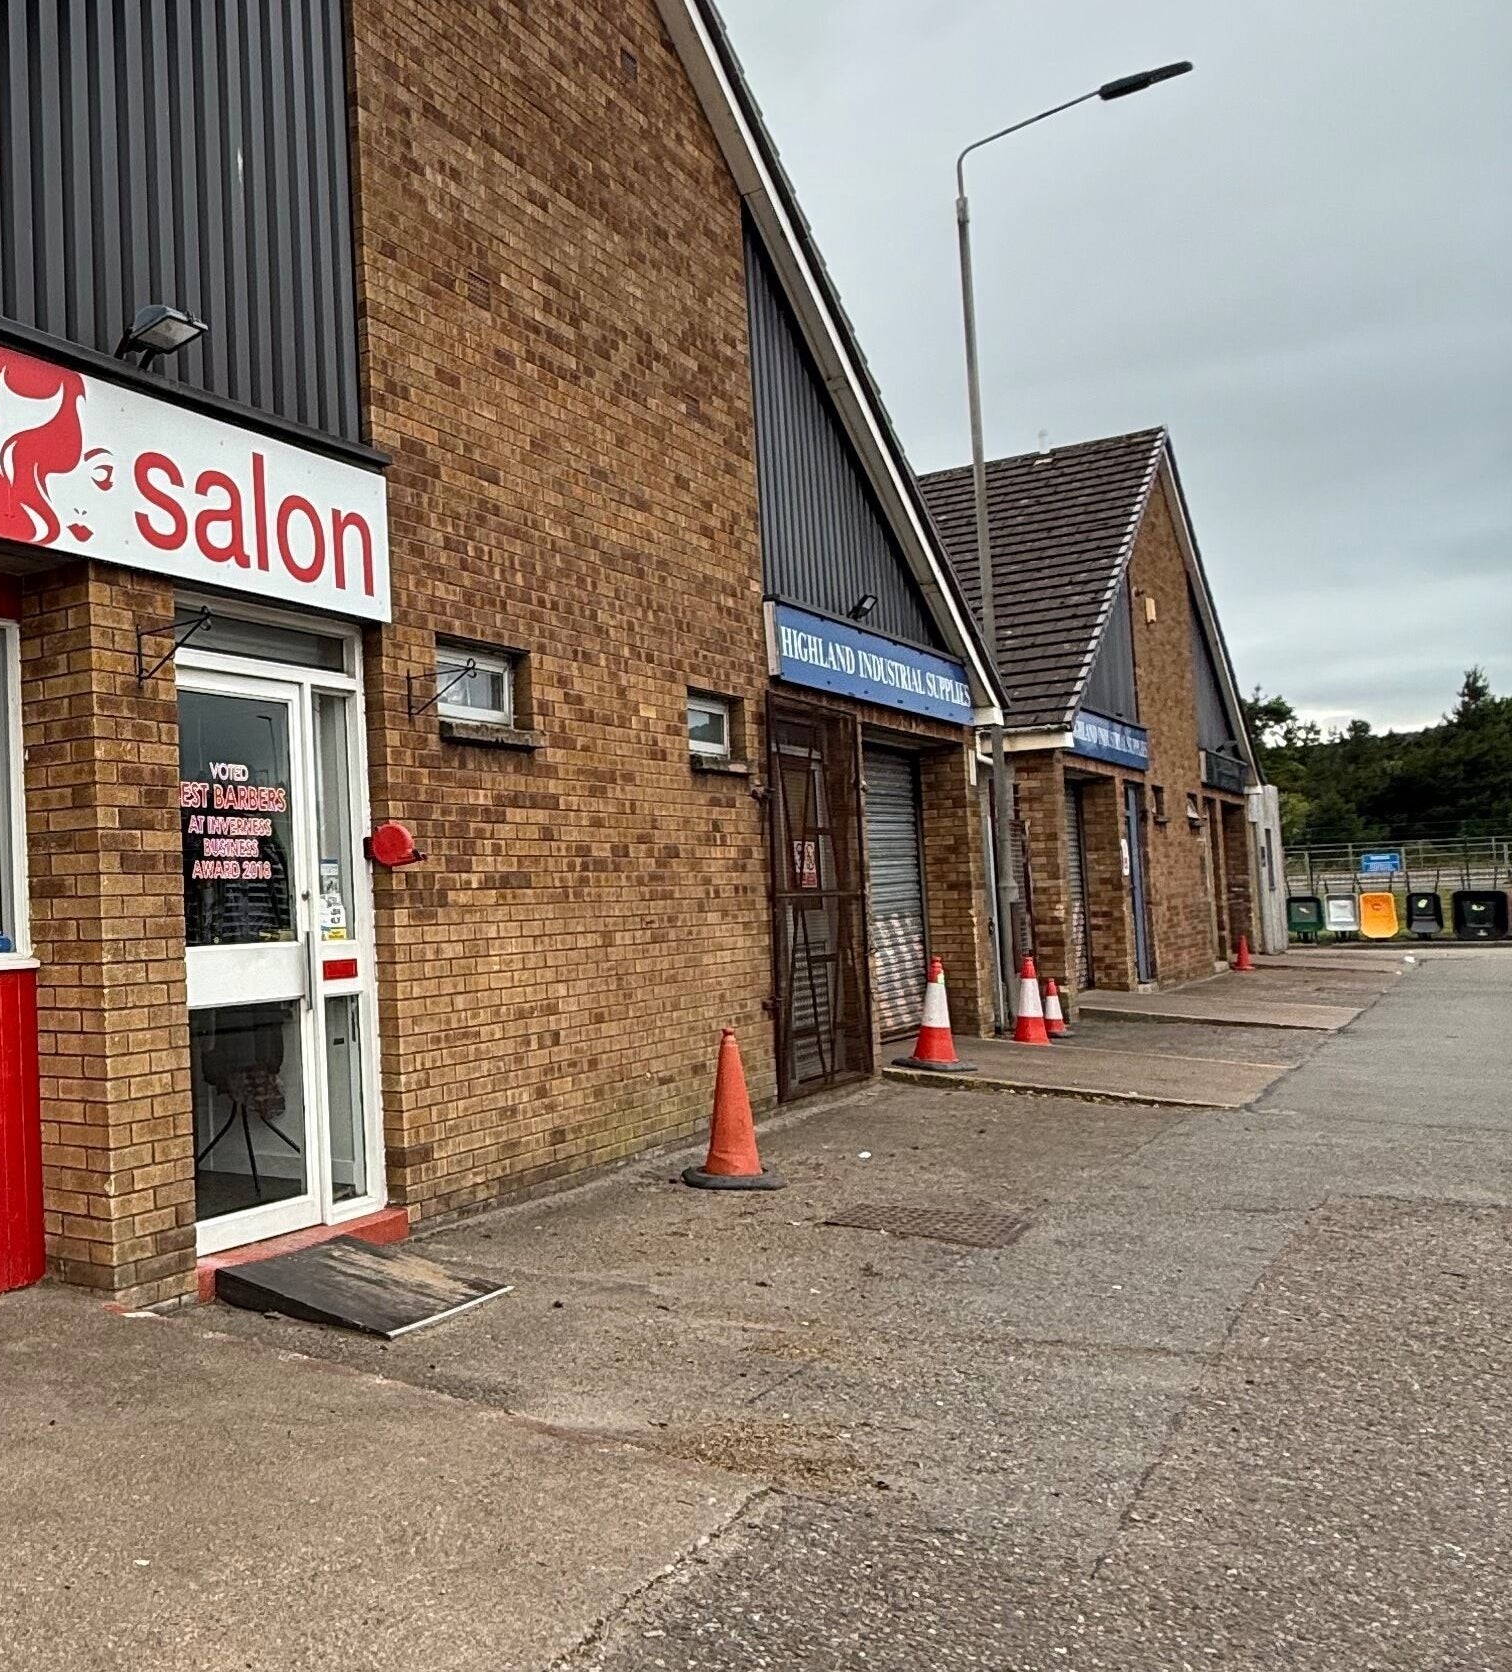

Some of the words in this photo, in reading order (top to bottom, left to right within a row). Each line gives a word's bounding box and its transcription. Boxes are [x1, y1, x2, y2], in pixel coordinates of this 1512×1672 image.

[133, 451, 375, 598] salon
[780, 626, 855, 674] HIGHLAND
[858, 651, 925, 695] INDUSTRIAL
[925, 672, 972, 707] SUPPLIES
[209, 762, 249, 781] VOTED
[180, 781, 209, 808] EST
[213, 784, 287, 812] BARBERS
[188, 815, 206, 834] AT
[207, 816, 273, 836] INVERNESS
[203, 838, 259, 857] BUSINESS
[191, 860, 241, 879] AWARD
